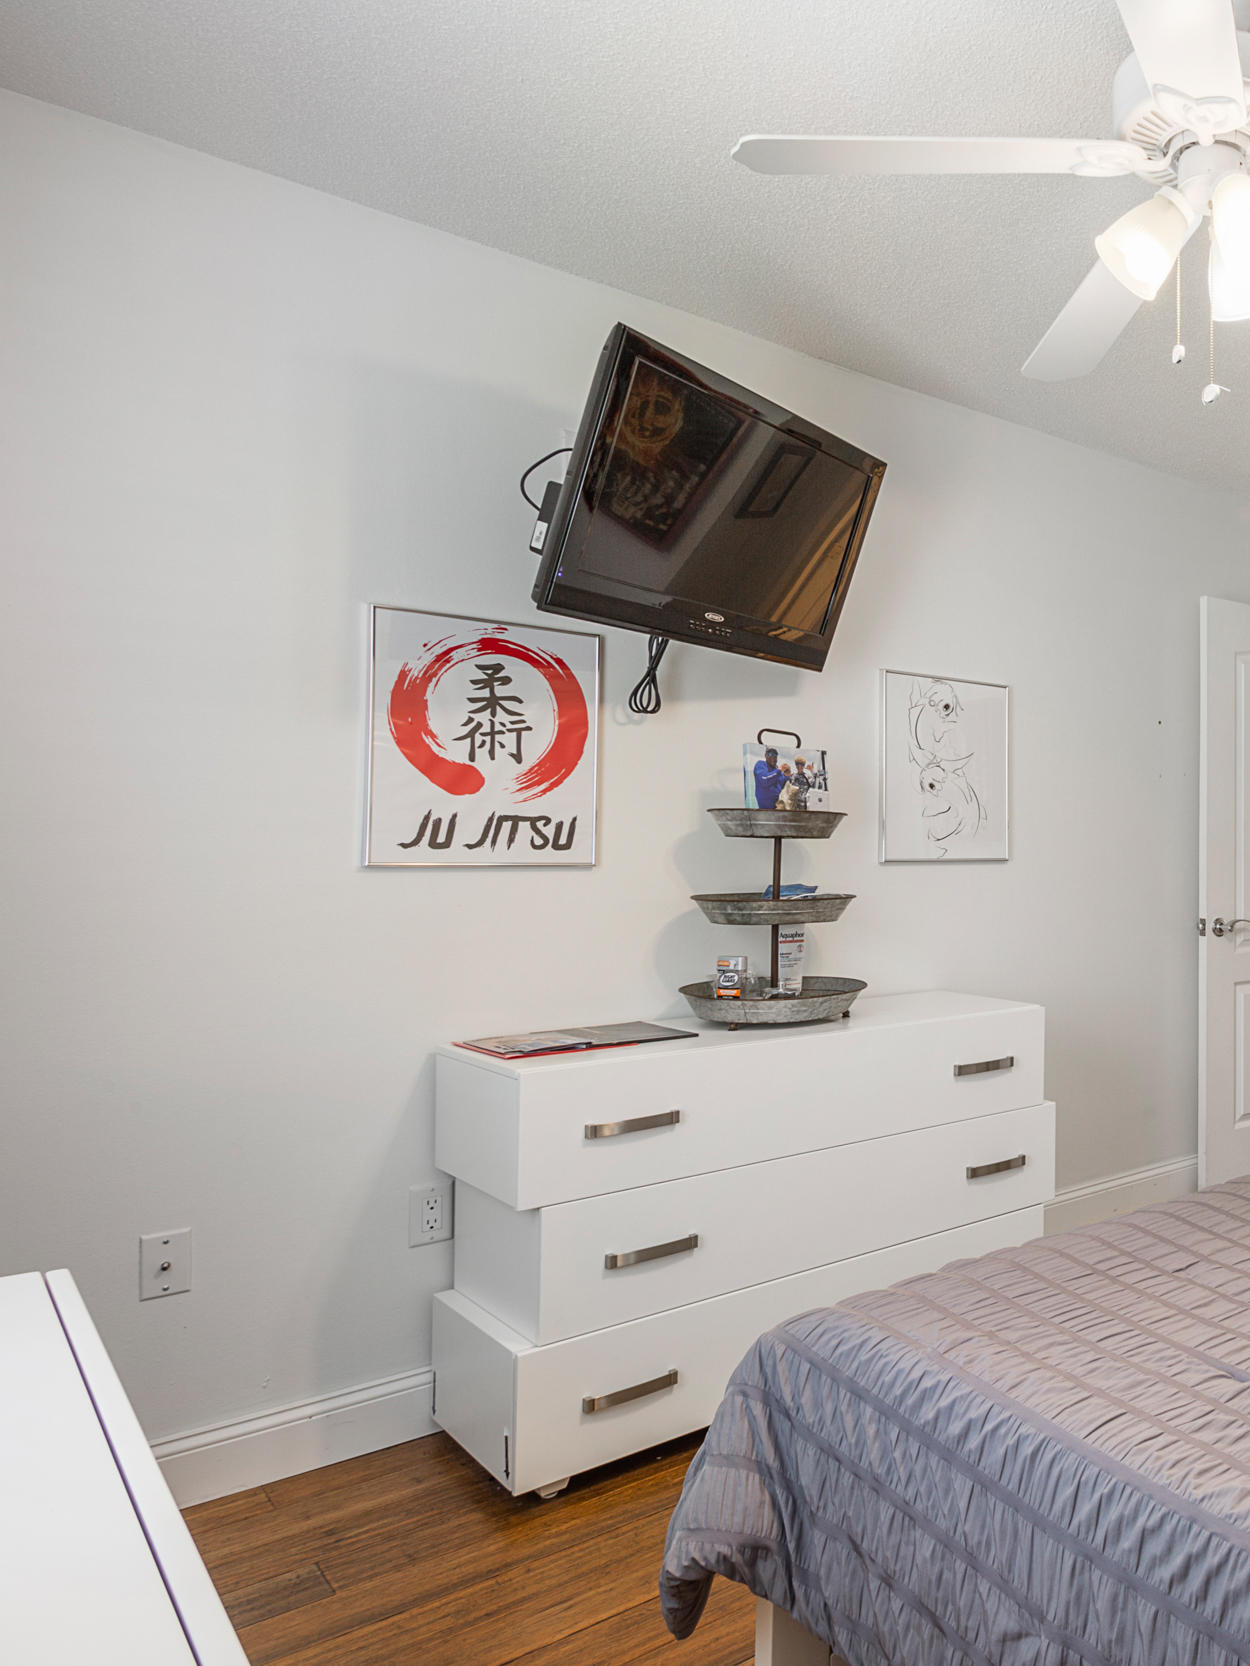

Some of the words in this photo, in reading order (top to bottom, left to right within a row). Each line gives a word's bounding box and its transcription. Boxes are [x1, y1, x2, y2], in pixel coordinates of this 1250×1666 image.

[451, 663, 533, 765] 柔術
[397, 809, 458, 850] JU
[462, 811, 578, 852] JITSU
[780, 931, 805, 941] Aquaphor
